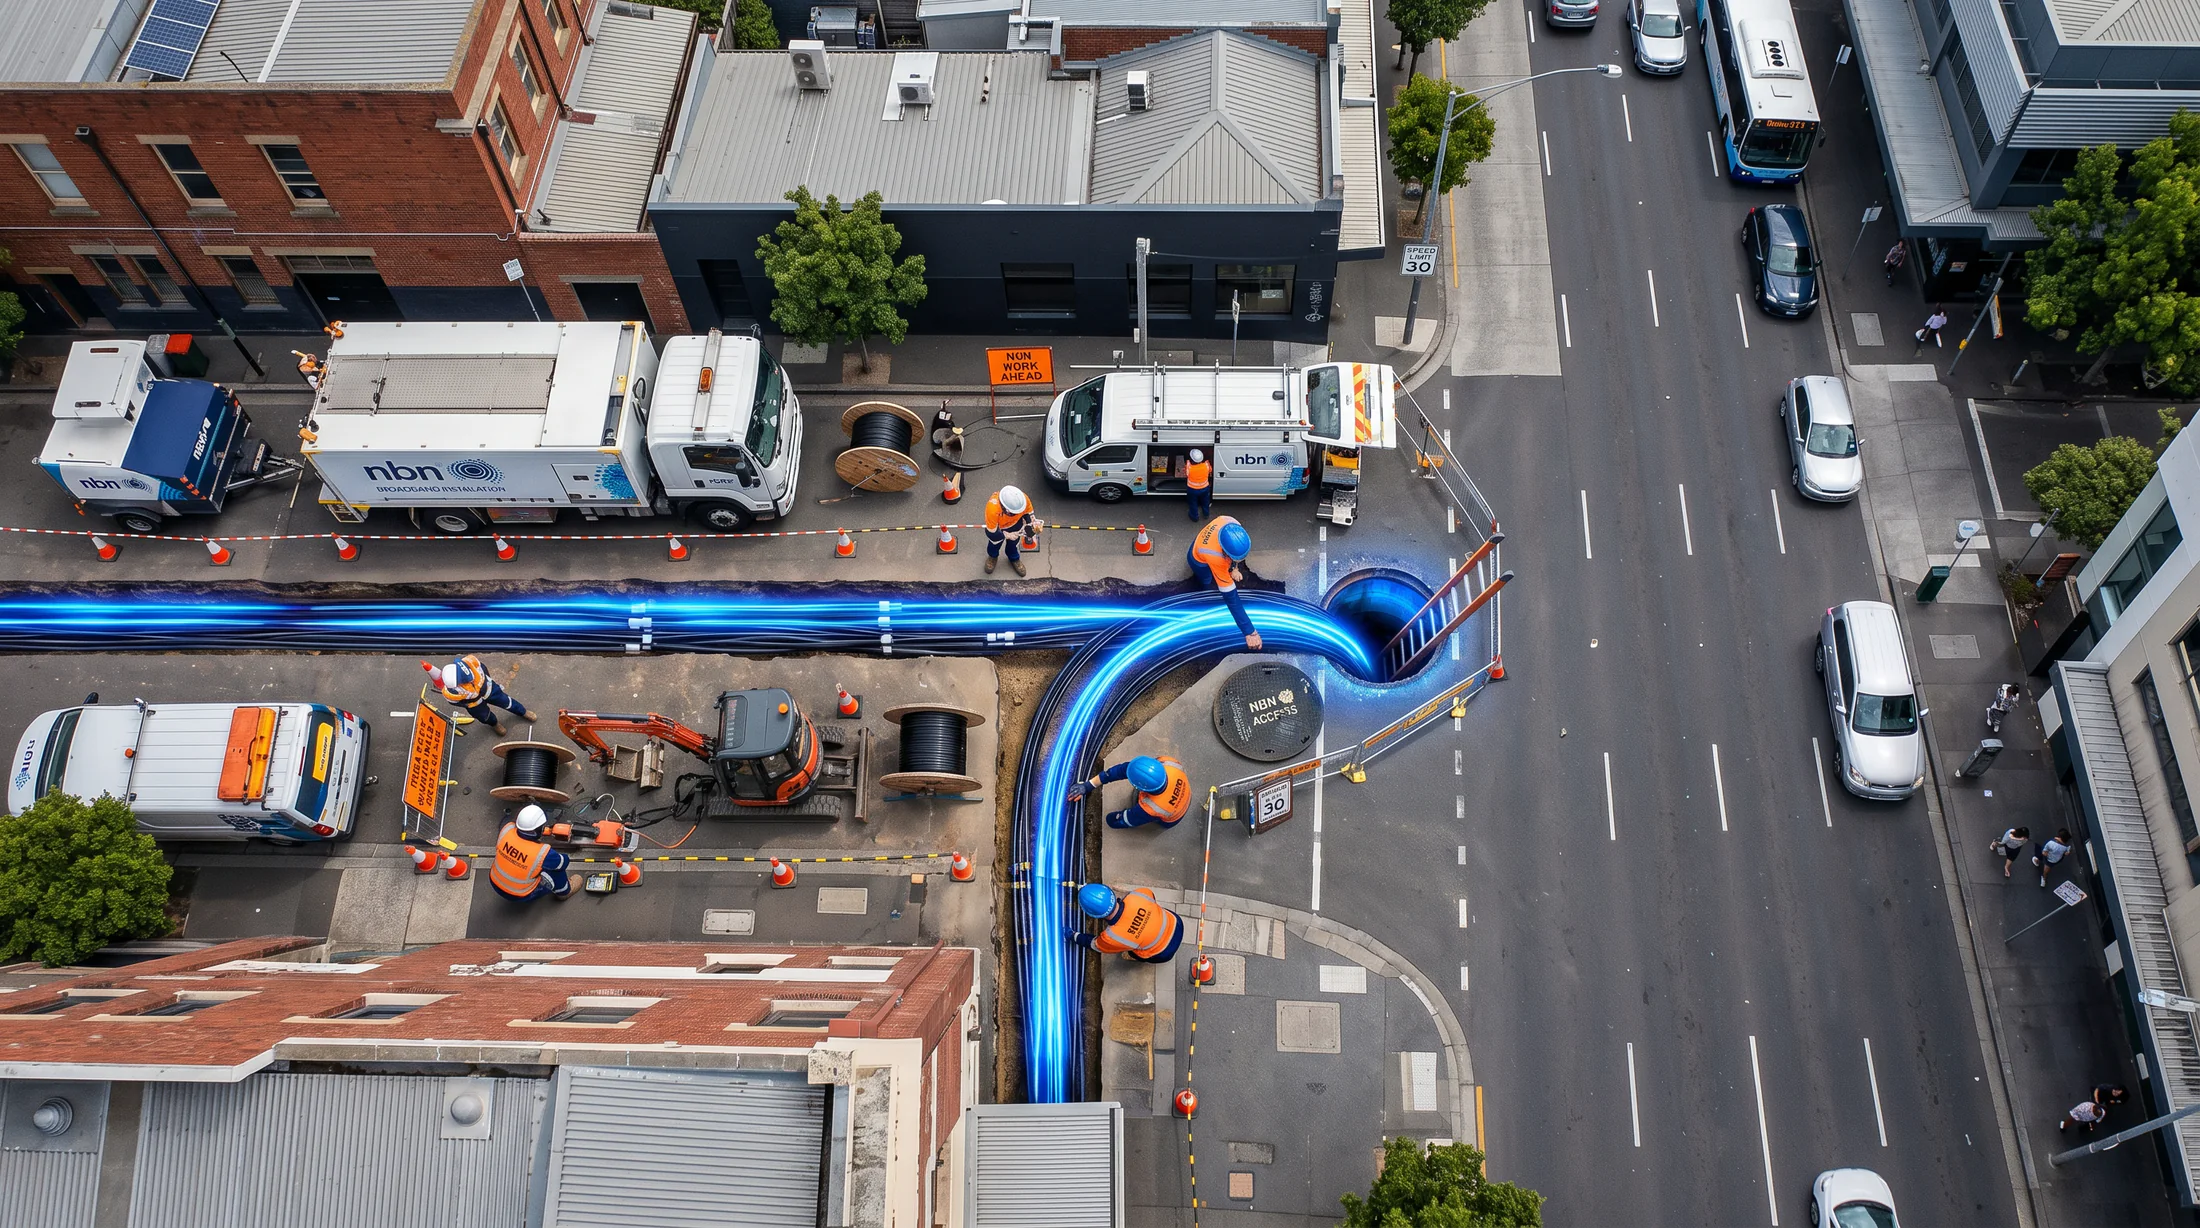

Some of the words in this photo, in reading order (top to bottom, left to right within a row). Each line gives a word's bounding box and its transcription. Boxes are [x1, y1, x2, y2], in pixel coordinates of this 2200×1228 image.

[1405, 261, 1431, 272] 30
[1003, 361, 1038, 371] WORK
[1001, 372, 1042, 381] AHEAD
[1235, 454, 1266, 465] nbn
[363, 460, 444, 481] nbn
[79, 477, 121, 489] nbn
[1249, 696, 1277, 713] NBN
[1264, 798, 1285, 816] 30
[503, 841, 528, 864] NBN
